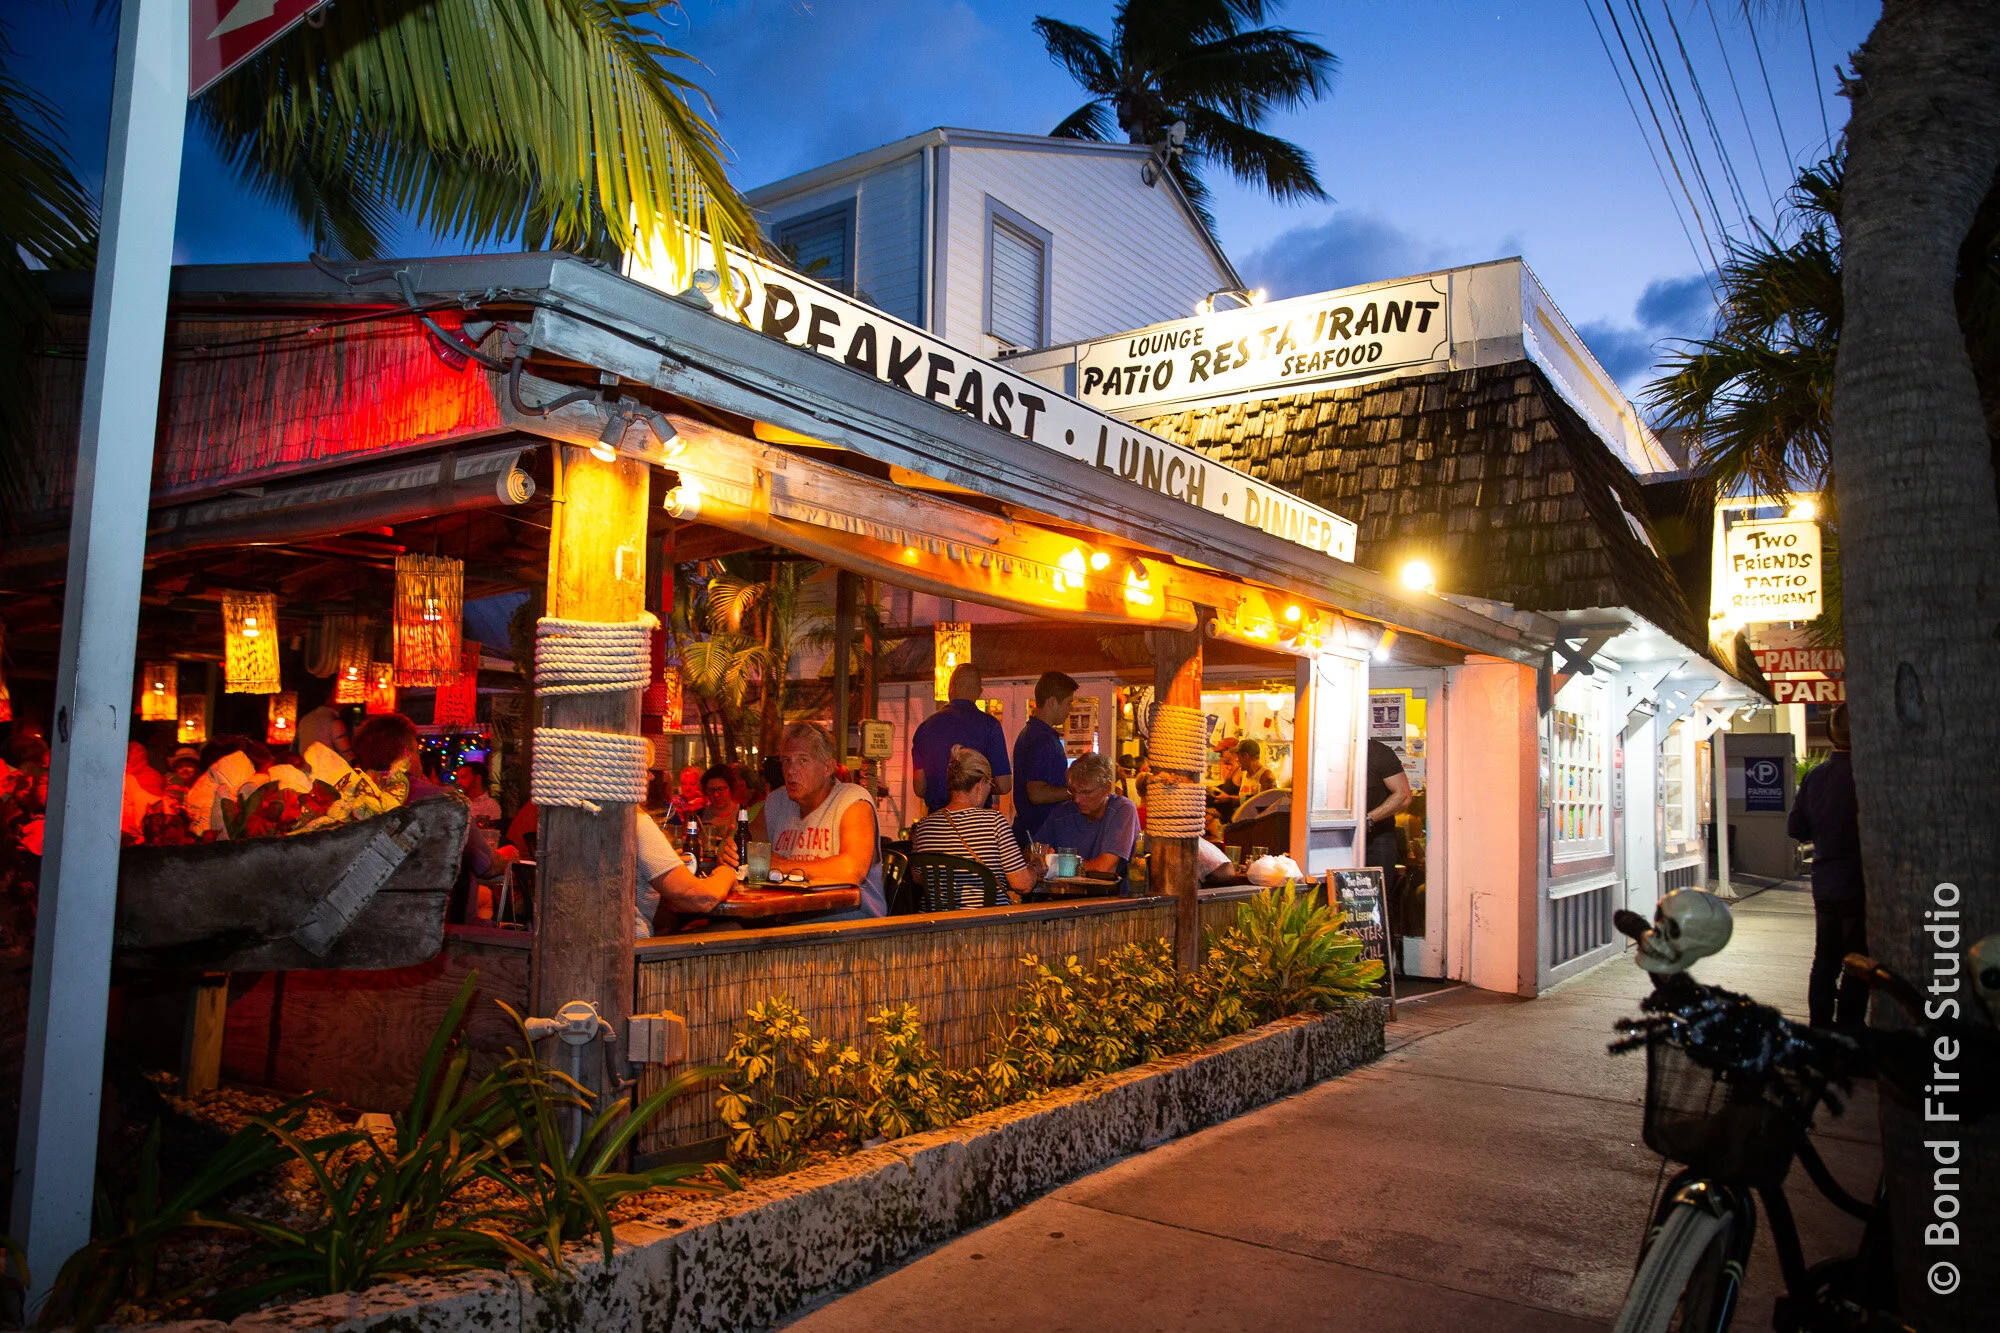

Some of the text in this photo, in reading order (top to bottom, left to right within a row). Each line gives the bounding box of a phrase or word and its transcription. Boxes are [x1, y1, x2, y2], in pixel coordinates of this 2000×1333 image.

[1128, 327, 1204, 359] LOUNGE
[1280, 341, 1383, 377] SEAFOOD
[1096, 425, 1206, 506] LUNCH
[1245, 488, 1332, 552] DINNER
[1732, 589, 1817, 607] RESTAURANT
[1747, 787, 1782, 796] PARKING
